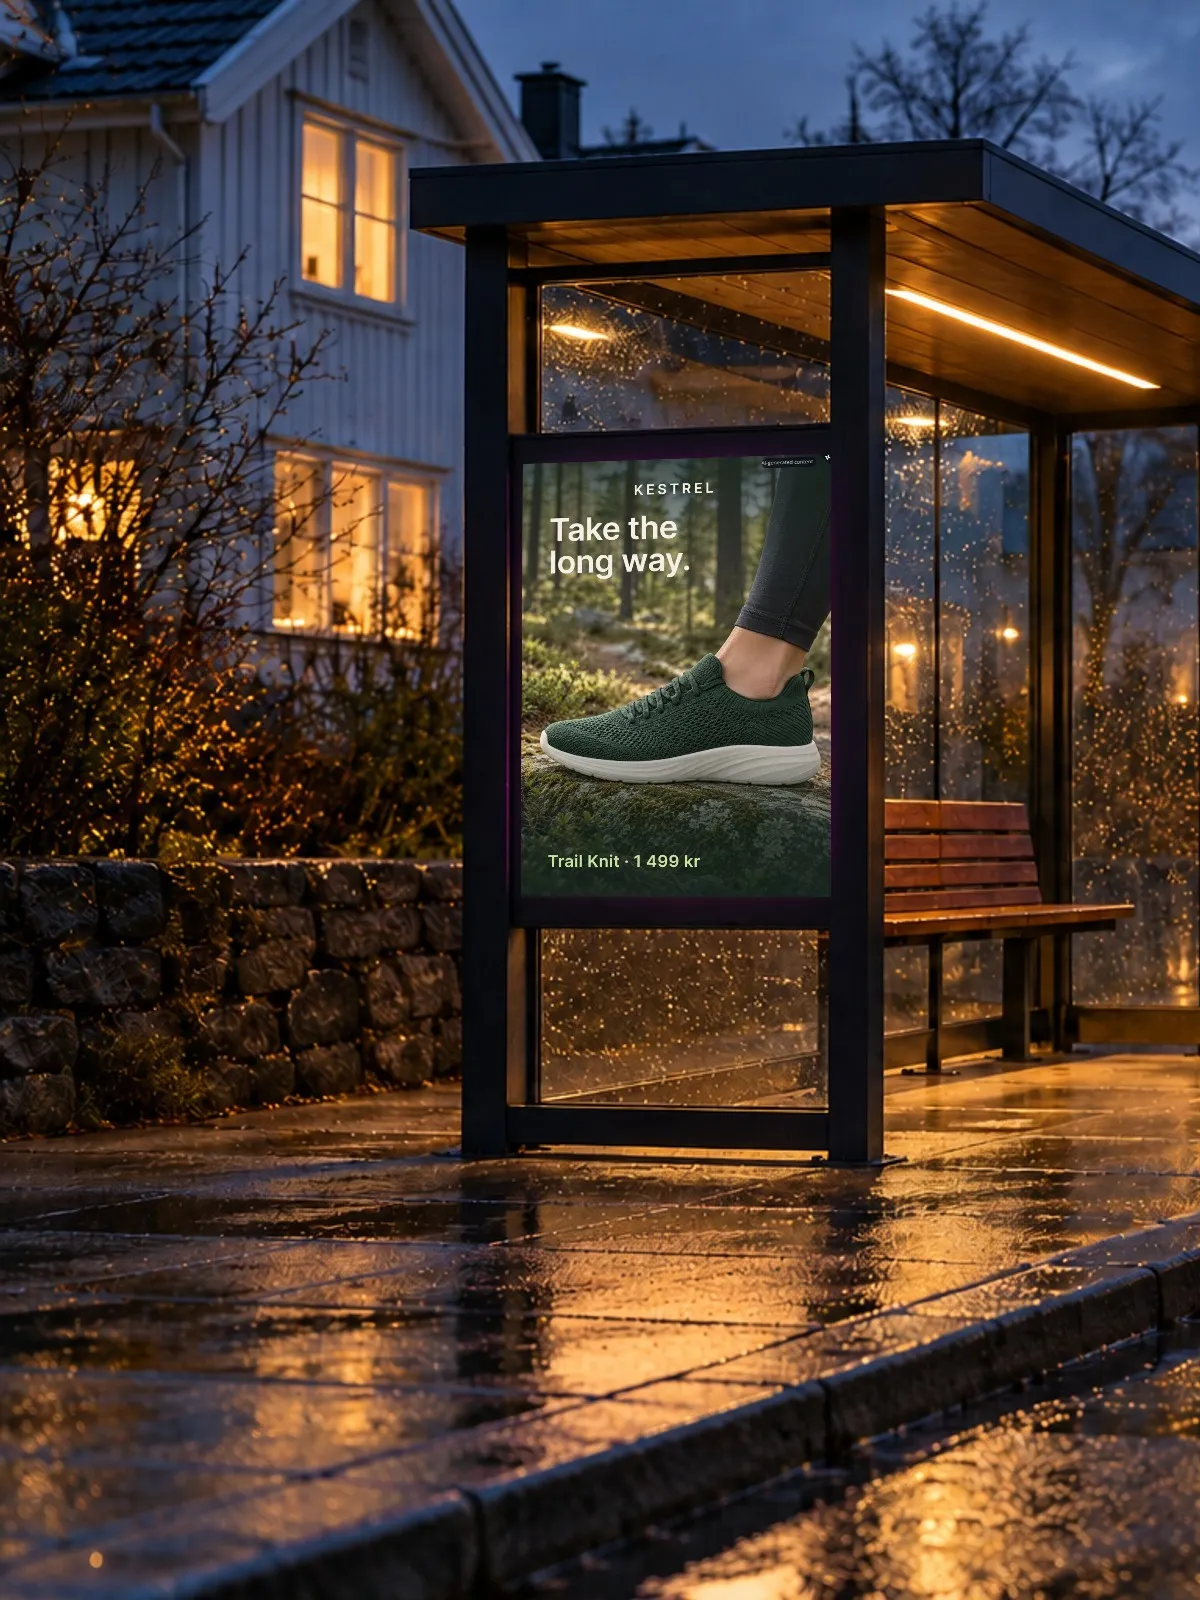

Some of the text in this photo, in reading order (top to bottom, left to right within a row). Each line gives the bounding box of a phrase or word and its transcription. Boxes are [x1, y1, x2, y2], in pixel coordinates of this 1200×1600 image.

[634, 482, 714, 496] KESTREL
[550, 515, 678, 542] Take the
[550, 550, 690, 580] long way.
[548, 854, 583, 868] Trail
[588, 854, 620, 868] Knit
[633, 855, 641, 868] 1
[646, 855, 679, 868] 499
[684, 854, 701, 868] kr
